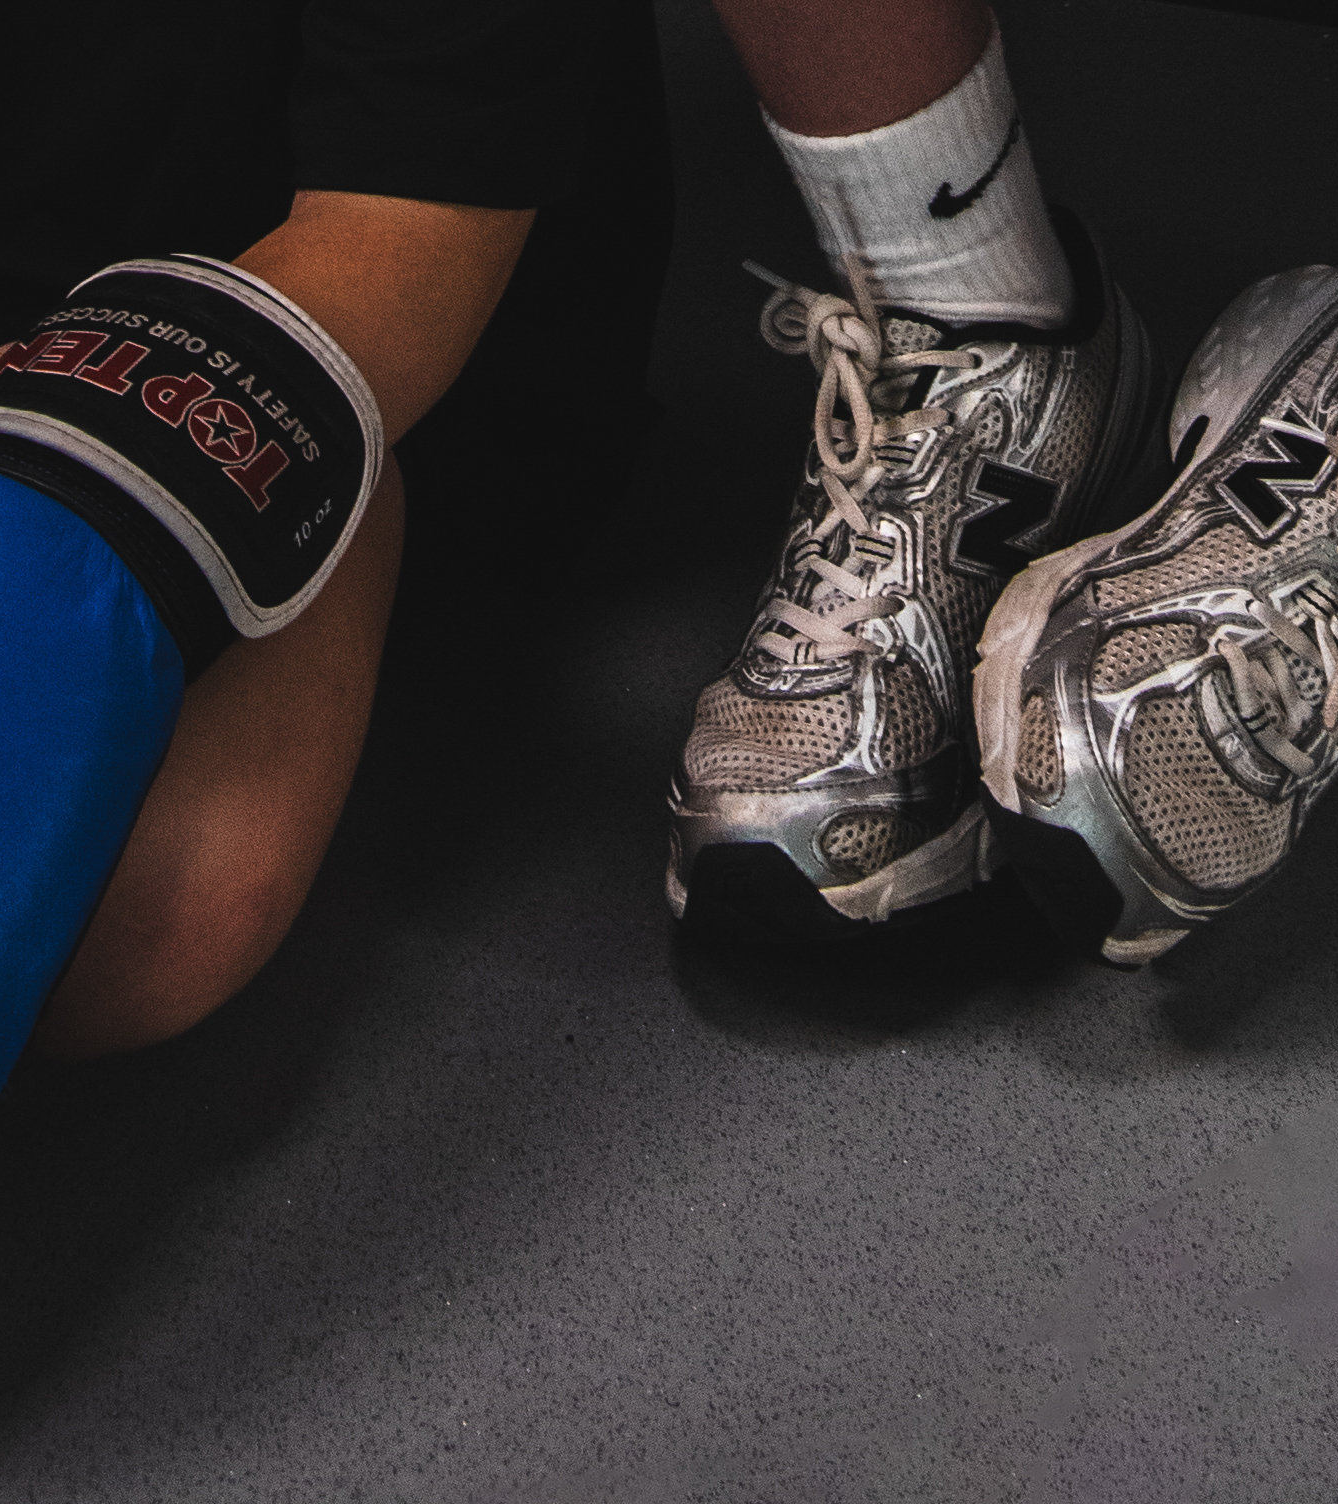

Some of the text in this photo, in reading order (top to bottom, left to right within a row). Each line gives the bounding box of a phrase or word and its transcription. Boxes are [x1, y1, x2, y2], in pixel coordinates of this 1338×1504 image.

[142, 372, 291, 513] TOP
[149, 320, 207, 355] OUR
[207, 349, 242, 377] IS
[237, 374, 321, 463] SAFETY
[293, 498, 334, 549] 10 oz
